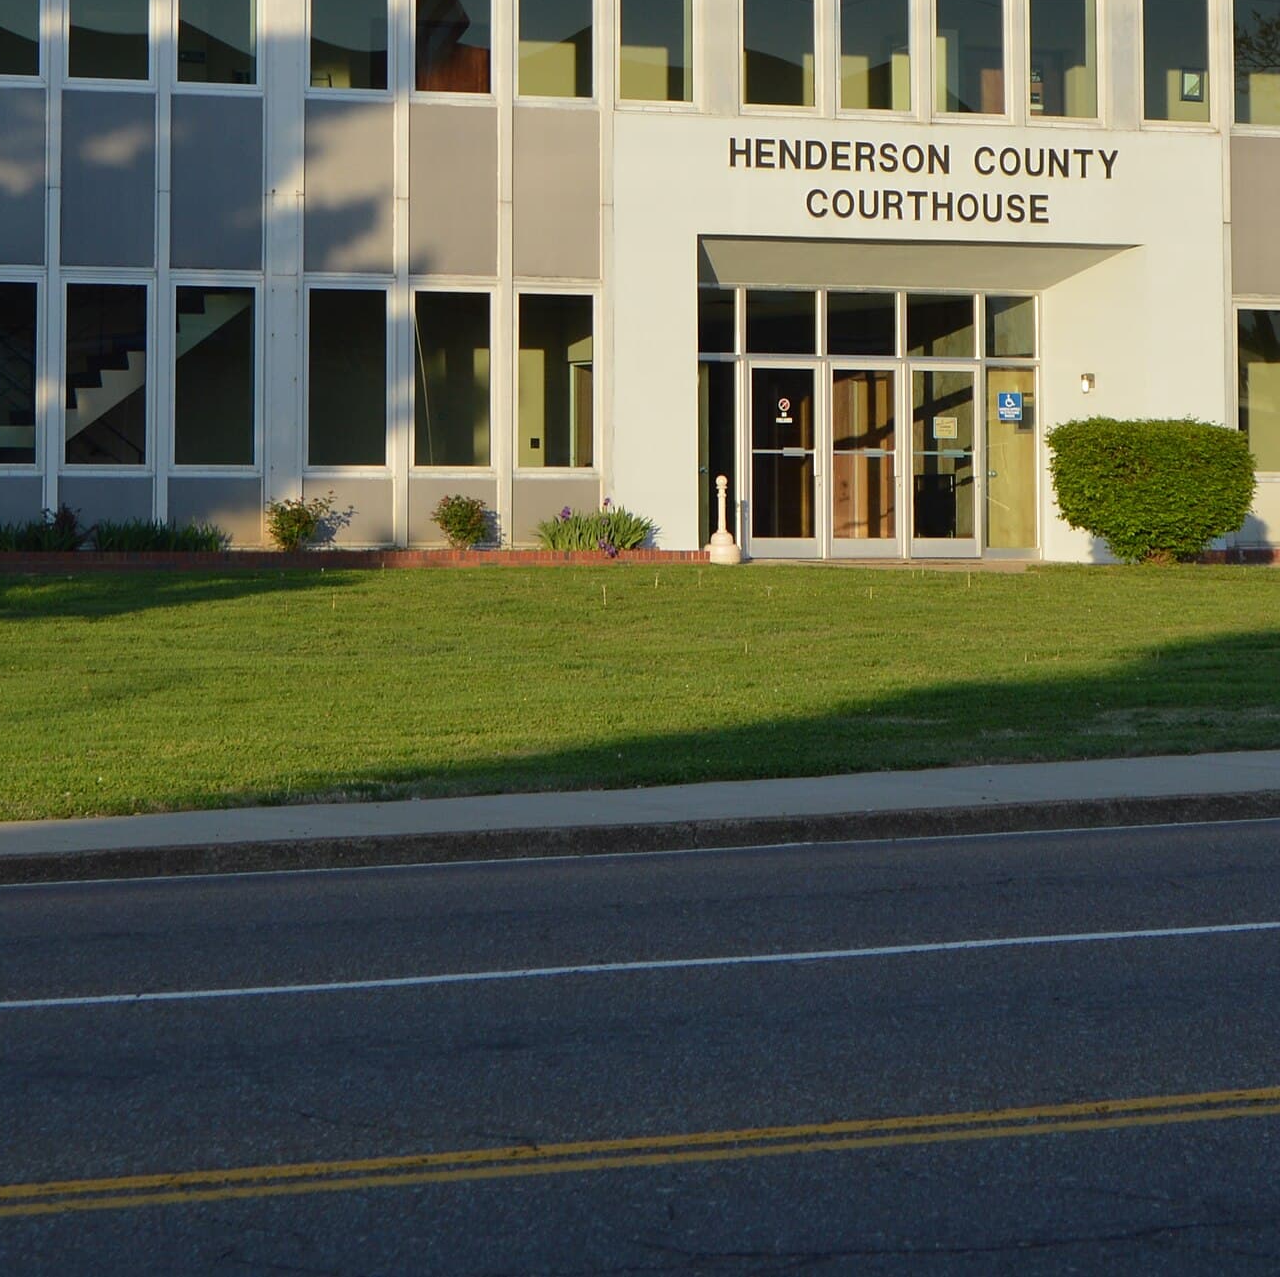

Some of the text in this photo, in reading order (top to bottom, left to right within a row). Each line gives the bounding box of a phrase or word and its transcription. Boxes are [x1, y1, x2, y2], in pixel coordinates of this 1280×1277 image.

[729, 137, 1119, 179] HENDERSON COUNTY
[806, 188, 1049, 223] COURTHOUSE
